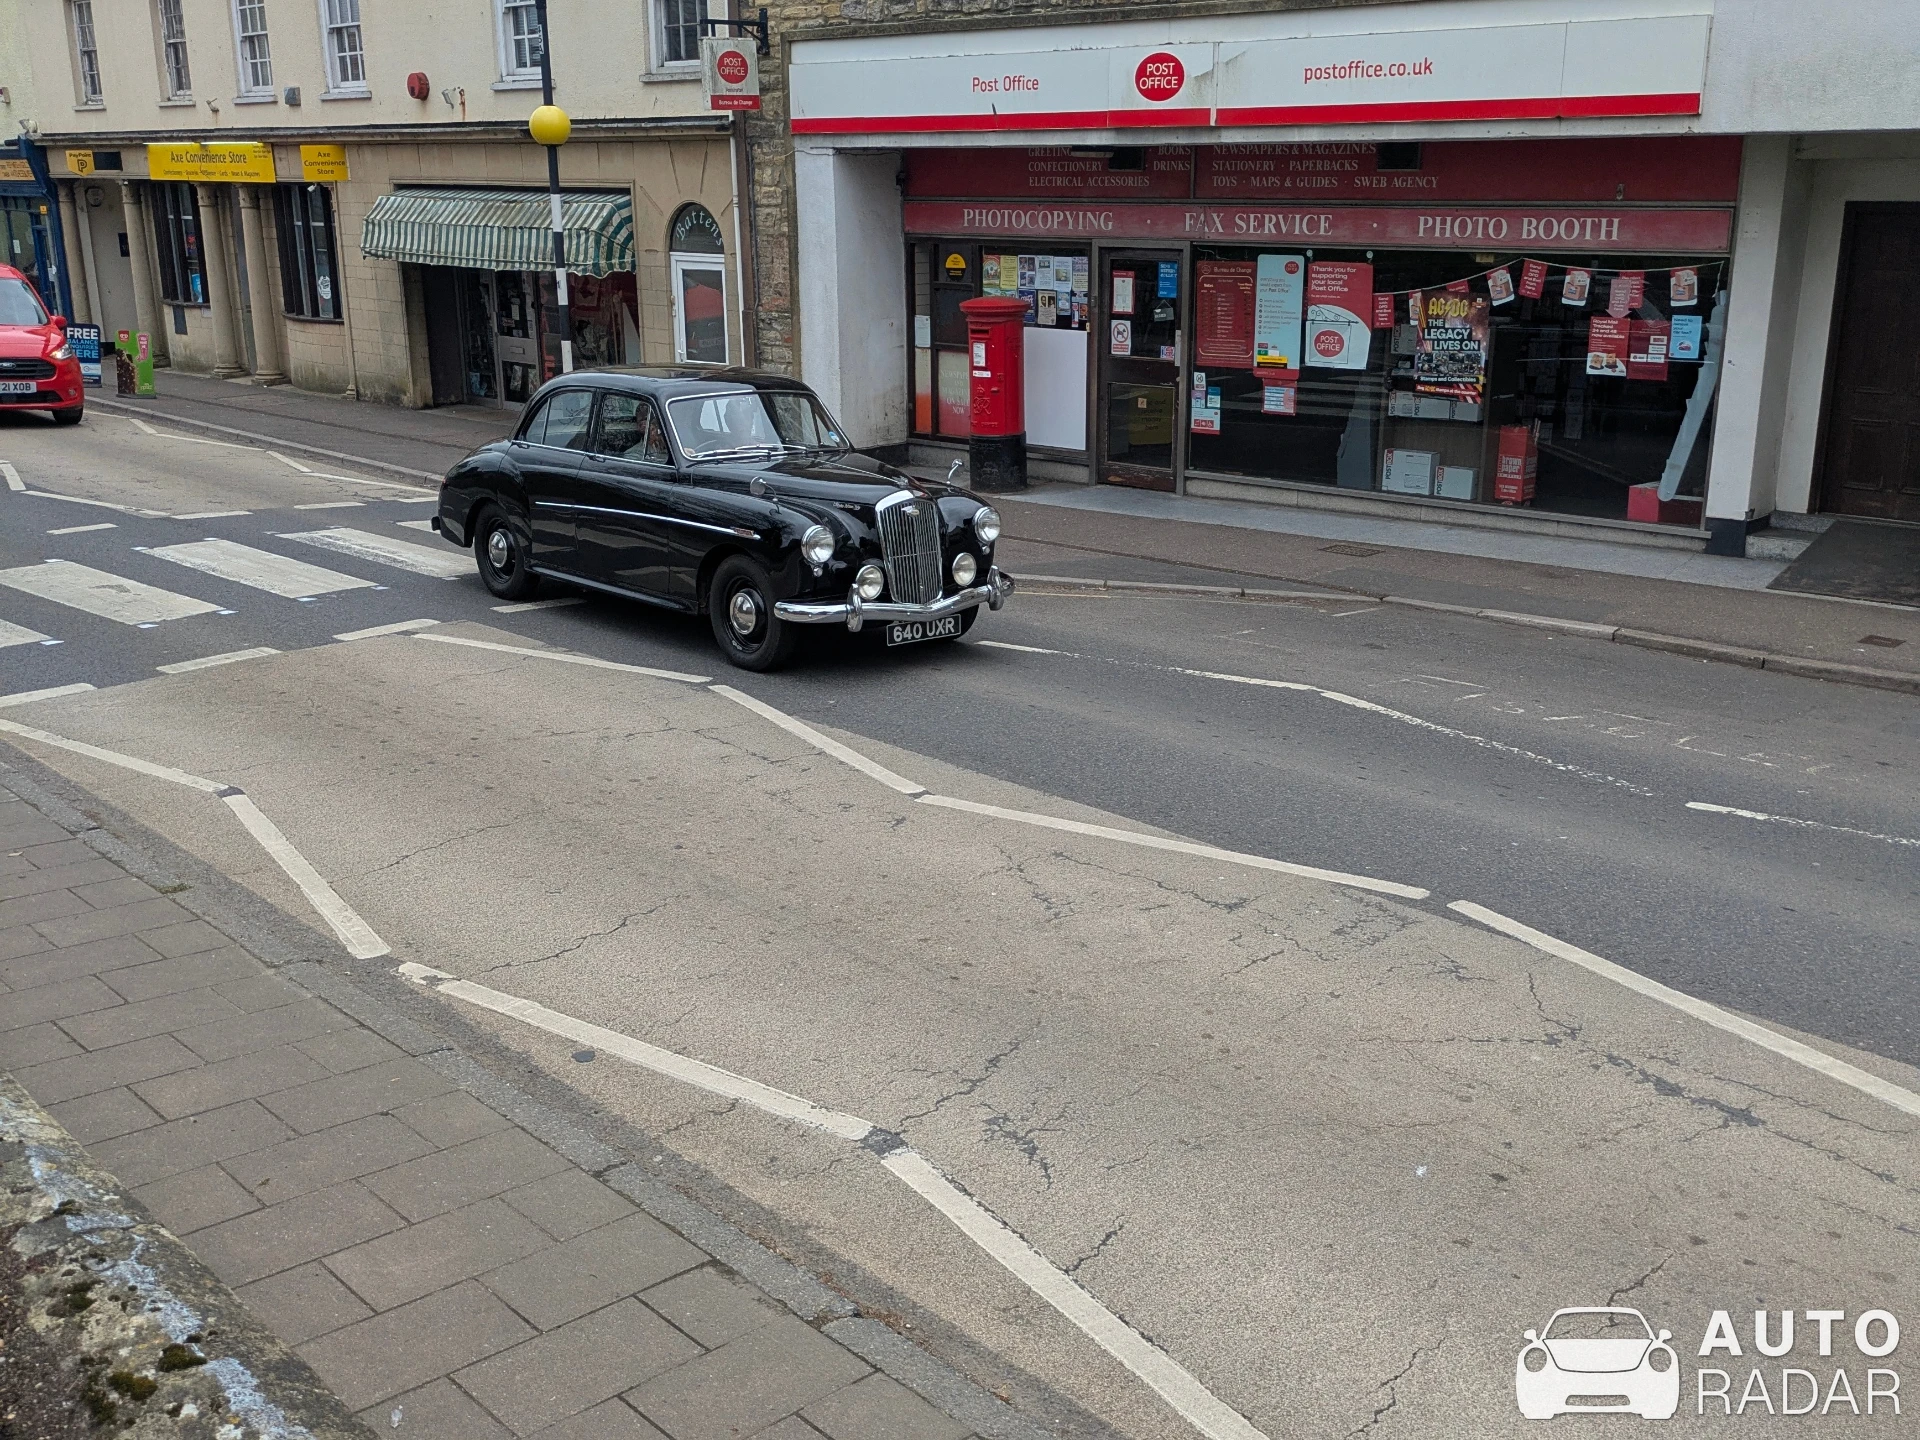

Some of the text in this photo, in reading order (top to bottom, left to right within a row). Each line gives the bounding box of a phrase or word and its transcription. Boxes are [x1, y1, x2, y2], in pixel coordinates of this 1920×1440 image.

[723, 57, 742, 66] POST
[720, 66, 745, 76] OFFICE
[1146, 62, 1175, 76] POST
[1304, 56, 1433, 84] postoffice.co.uk
[972, 75, 1039, 92] Post Office
[1139, 76, 1178, 90] OFFICE
[1212, 144, 1290, 156] NEWSPAPERS
[1302, 143, 1376, 155] MAGAZINES
[170, 152, 184, 163] Axe
[185, 151, 226, 164] Convenience
[228, 151, 248, 164] Store
[1028, 160, 1191, 172] CONFECTIONERY DRINKS
[1212, 160, 1359, 171] STATIONERY PAPERBACKS
[1029, 176, 1150, 187] ELECTRICAL ACCESSORIES
[1212, 176, 1439, 188] TOYS MAPS & GUIDES SWEB AGENCY
[676, 210, 723, 246] Battens
[963, 208, 1621, 242] PHOTOCOPYING FAX SERVICE PHOTO BOOTH
[1428, 319, 1444, 327] THE
[66, 327, 98, 339] FREE
[1424, 328, 1470, 340] LEGACY
[1434, 340, 1479, 350] LIVES ON
[2, 382, 31, 391] 21 XOB
[952, 406, 966, 414] NOW
[1502, 456, 1522, 466] brown
[1501, 464, 1521, 474] paper
[893, 618, 955, 642] 640 UXR
